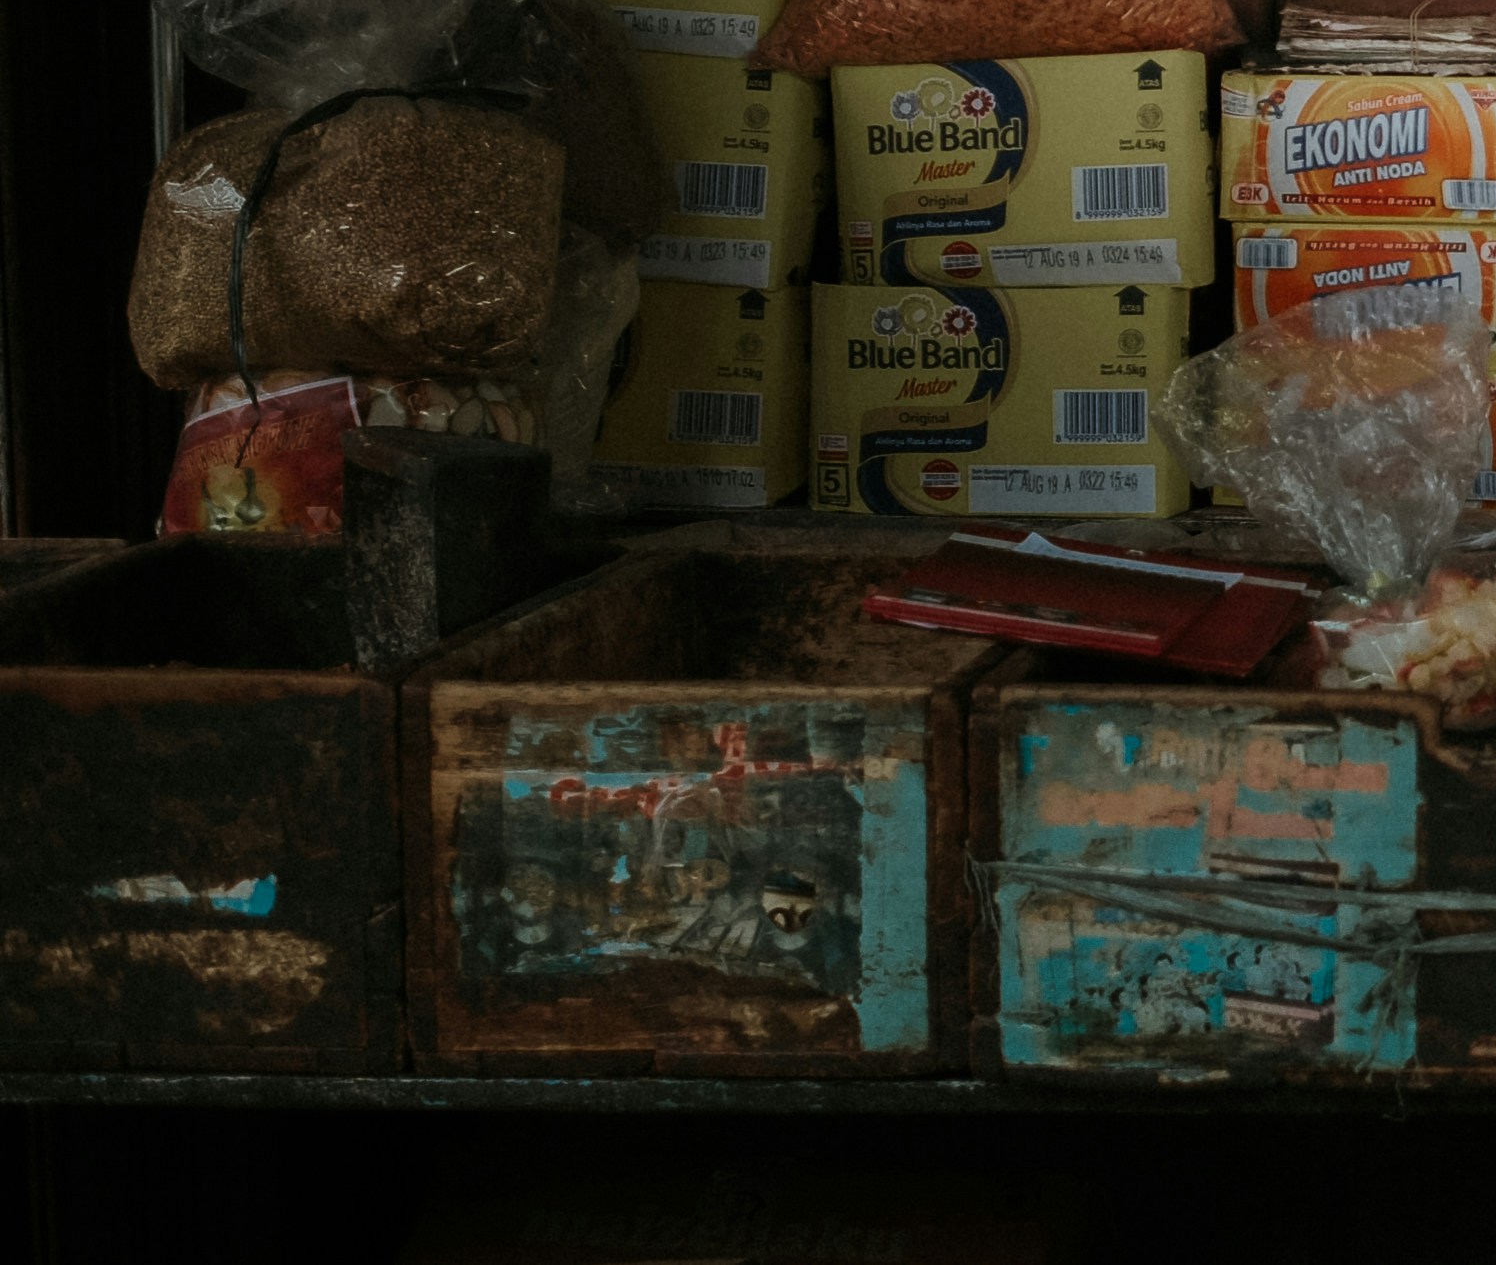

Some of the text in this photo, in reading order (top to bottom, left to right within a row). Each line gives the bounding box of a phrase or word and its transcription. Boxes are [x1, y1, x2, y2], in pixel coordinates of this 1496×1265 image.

[675, 18, 682, 34] A
[721, 19, 756, 38] 15:49
[1347, 92, 1423, 113] Sabun Cream
[738, 137, 769, 152] 4.5kg
[867, 117, 1024, 155] Blue Band
[1134, 138, 1166, 152] 4.5kg
[1285, 106, 1430, 174] EKONOMI
[913, 160, 976, 185] Master
[1333, 160, 1426, 188] ANTI NODA
[917, 194, 969, 209] Original
[1237, 186, 1263, 202] E3K
[1317, 195, 1433, 207] Harum Bersih
[926, 220, 944, 229] Rasa
[947, 220, 962, 228] dan
[964, 219, 991, 228] Aroma
[665, 242, 678, 260] 19
[682, 243, 692, 263] A
[700, 242, 727, 262] 0323
[732, 242, 767, 261] 15:49
[1040, 250, 1065, 269] AUG
[1068, 251, 1080, 267] 19
[1086, 249, 1094, 265] A
[1102, 245, 1130, 264] 0324
[1134, 245, 1163, 264] 15:49
[855, 256, 868, 279] 5
[1312, 260, 1412, 288] ANTI NODA
[1121, 304, 1142, 313] ATAS
[848, 337, 1004, 371] Blue Band
[1115, 364, 1146, 377] 4.5kg
[895, 377, 957, 400] Master
[899, 412, 950, 426] Original
[907, 437, 926, 446] Rasa
[928, 437, 944, 446] dan
[1106, 433, 1142, 443] 032159
[725, 471, 755, 488] 17:02
[824, 470, 840, 493] 5
[1021, 473, 1044, 495] AUG
[1063, 475, 1072, 494] A
[1079, 470, 1105, 491] 0322
[1110, 471, 1138, 491] 15:49
